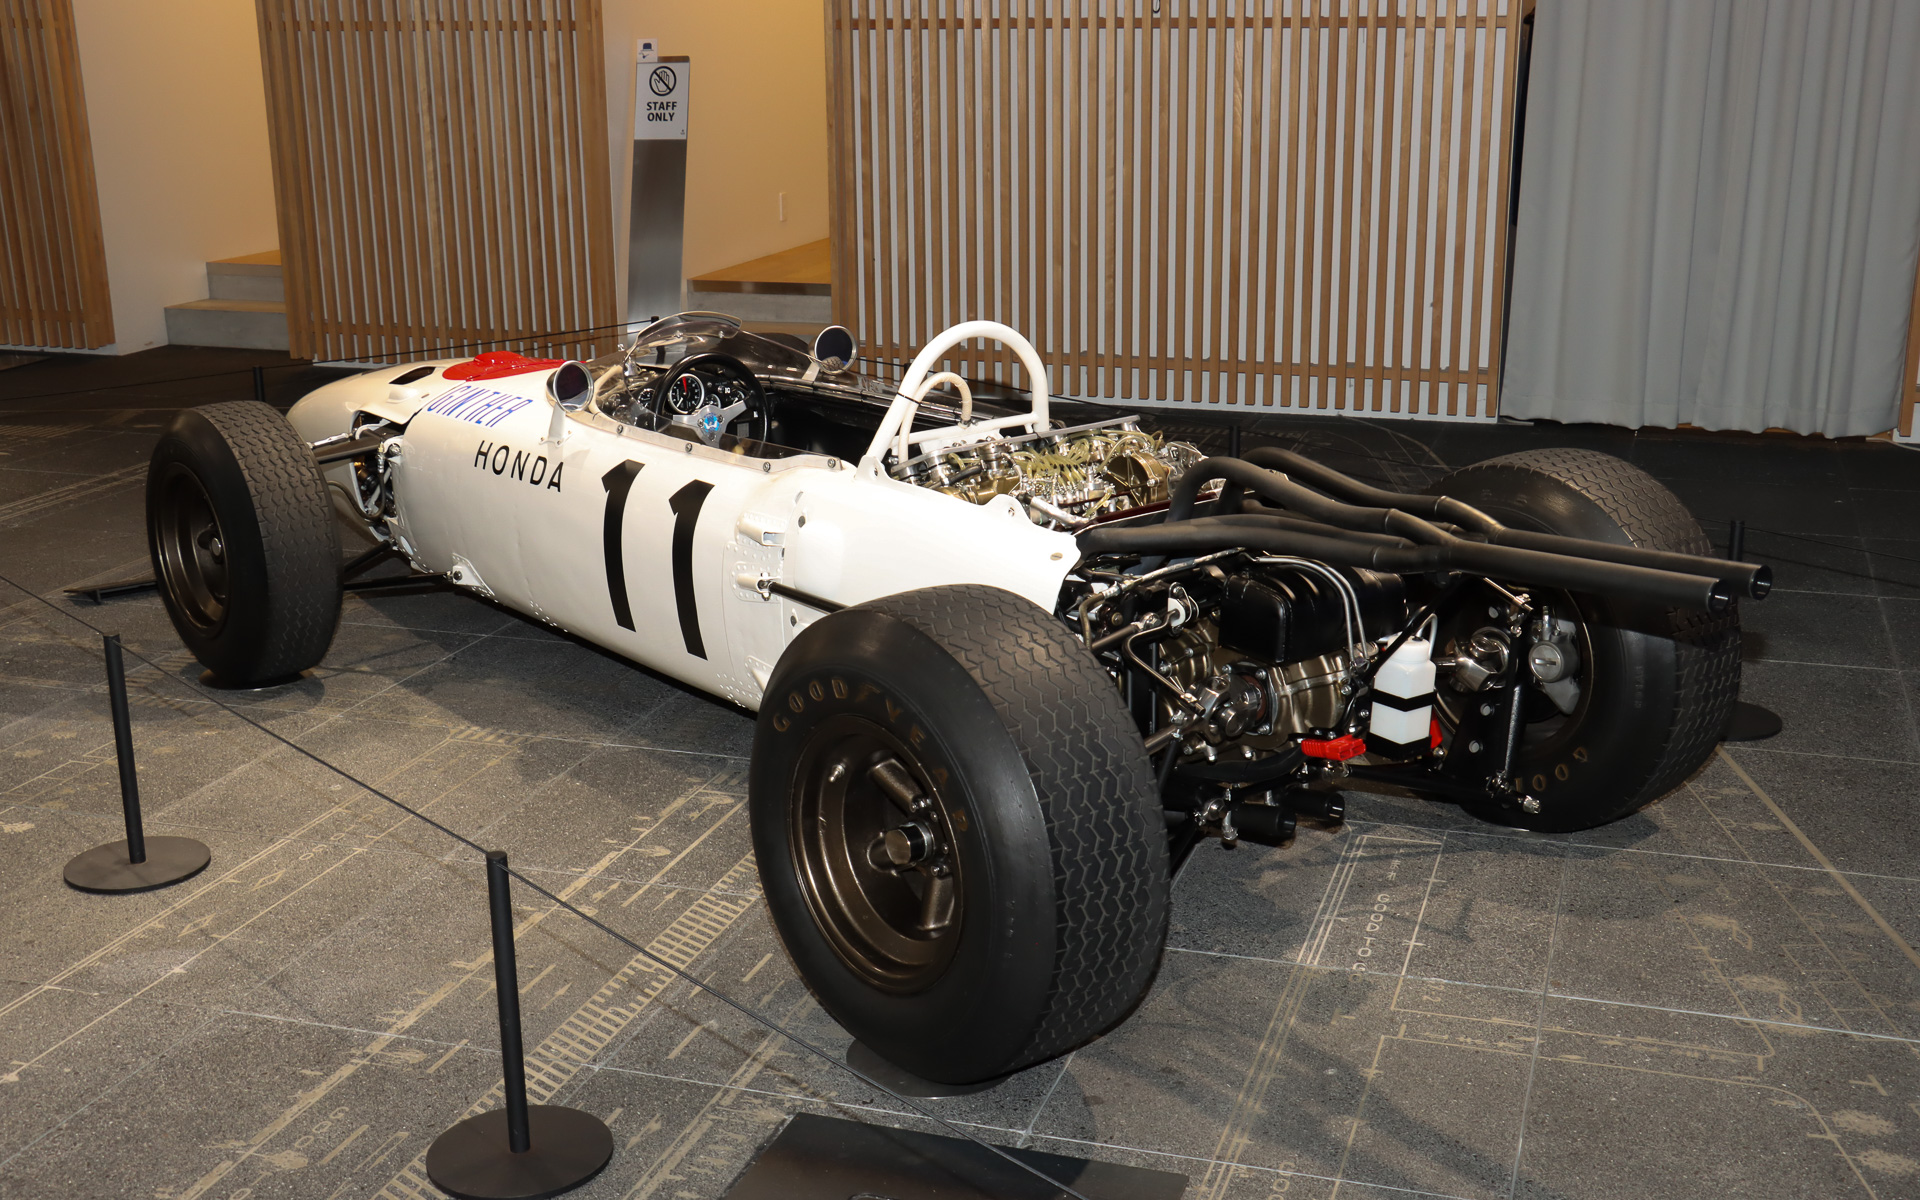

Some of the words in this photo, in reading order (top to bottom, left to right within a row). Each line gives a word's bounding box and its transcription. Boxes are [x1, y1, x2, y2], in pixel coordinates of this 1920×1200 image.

[646, 101, 677, 111] STAFF
[647, 112, 675, 121] ONLY
[427, 385, 534, 428] GINTHER
[473, 440, 563, 492] HONDA
[601, 459, 716, 661] 11
[1366, 893, 1391, 933] GOOD
[1357, 937, 1377, 957] TO
